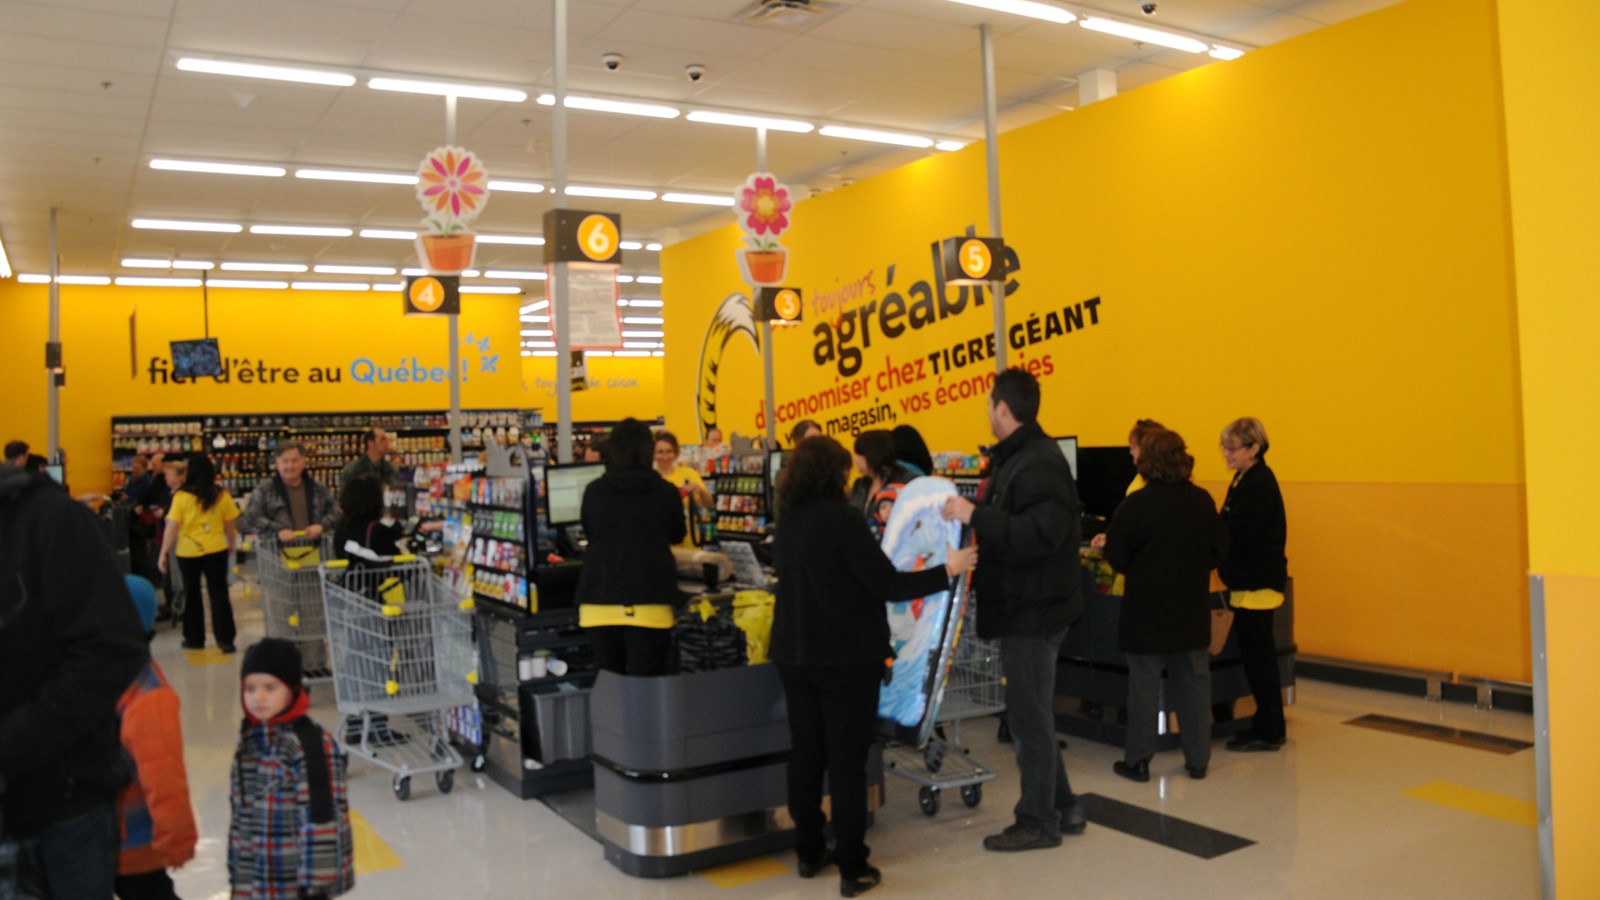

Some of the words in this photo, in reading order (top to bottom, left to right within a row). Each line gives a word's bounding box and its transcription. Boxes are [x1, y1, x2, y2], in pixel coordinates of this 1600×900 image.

[588, 222, 610, 253] 6
[968, 246, 985, 273] 5
[417, 283, 436, 305] 4
[782, 294, 795, 315] 3
[876, 355, 927, 393] chez
[928, 333, 997, 375] TIGRE
[1009, 297, 1101, 350] GÉANT
[308, 365, 342, 383] au
[826, 398, 897, 438] magasin,
[900, 391, 931, 415] vos
